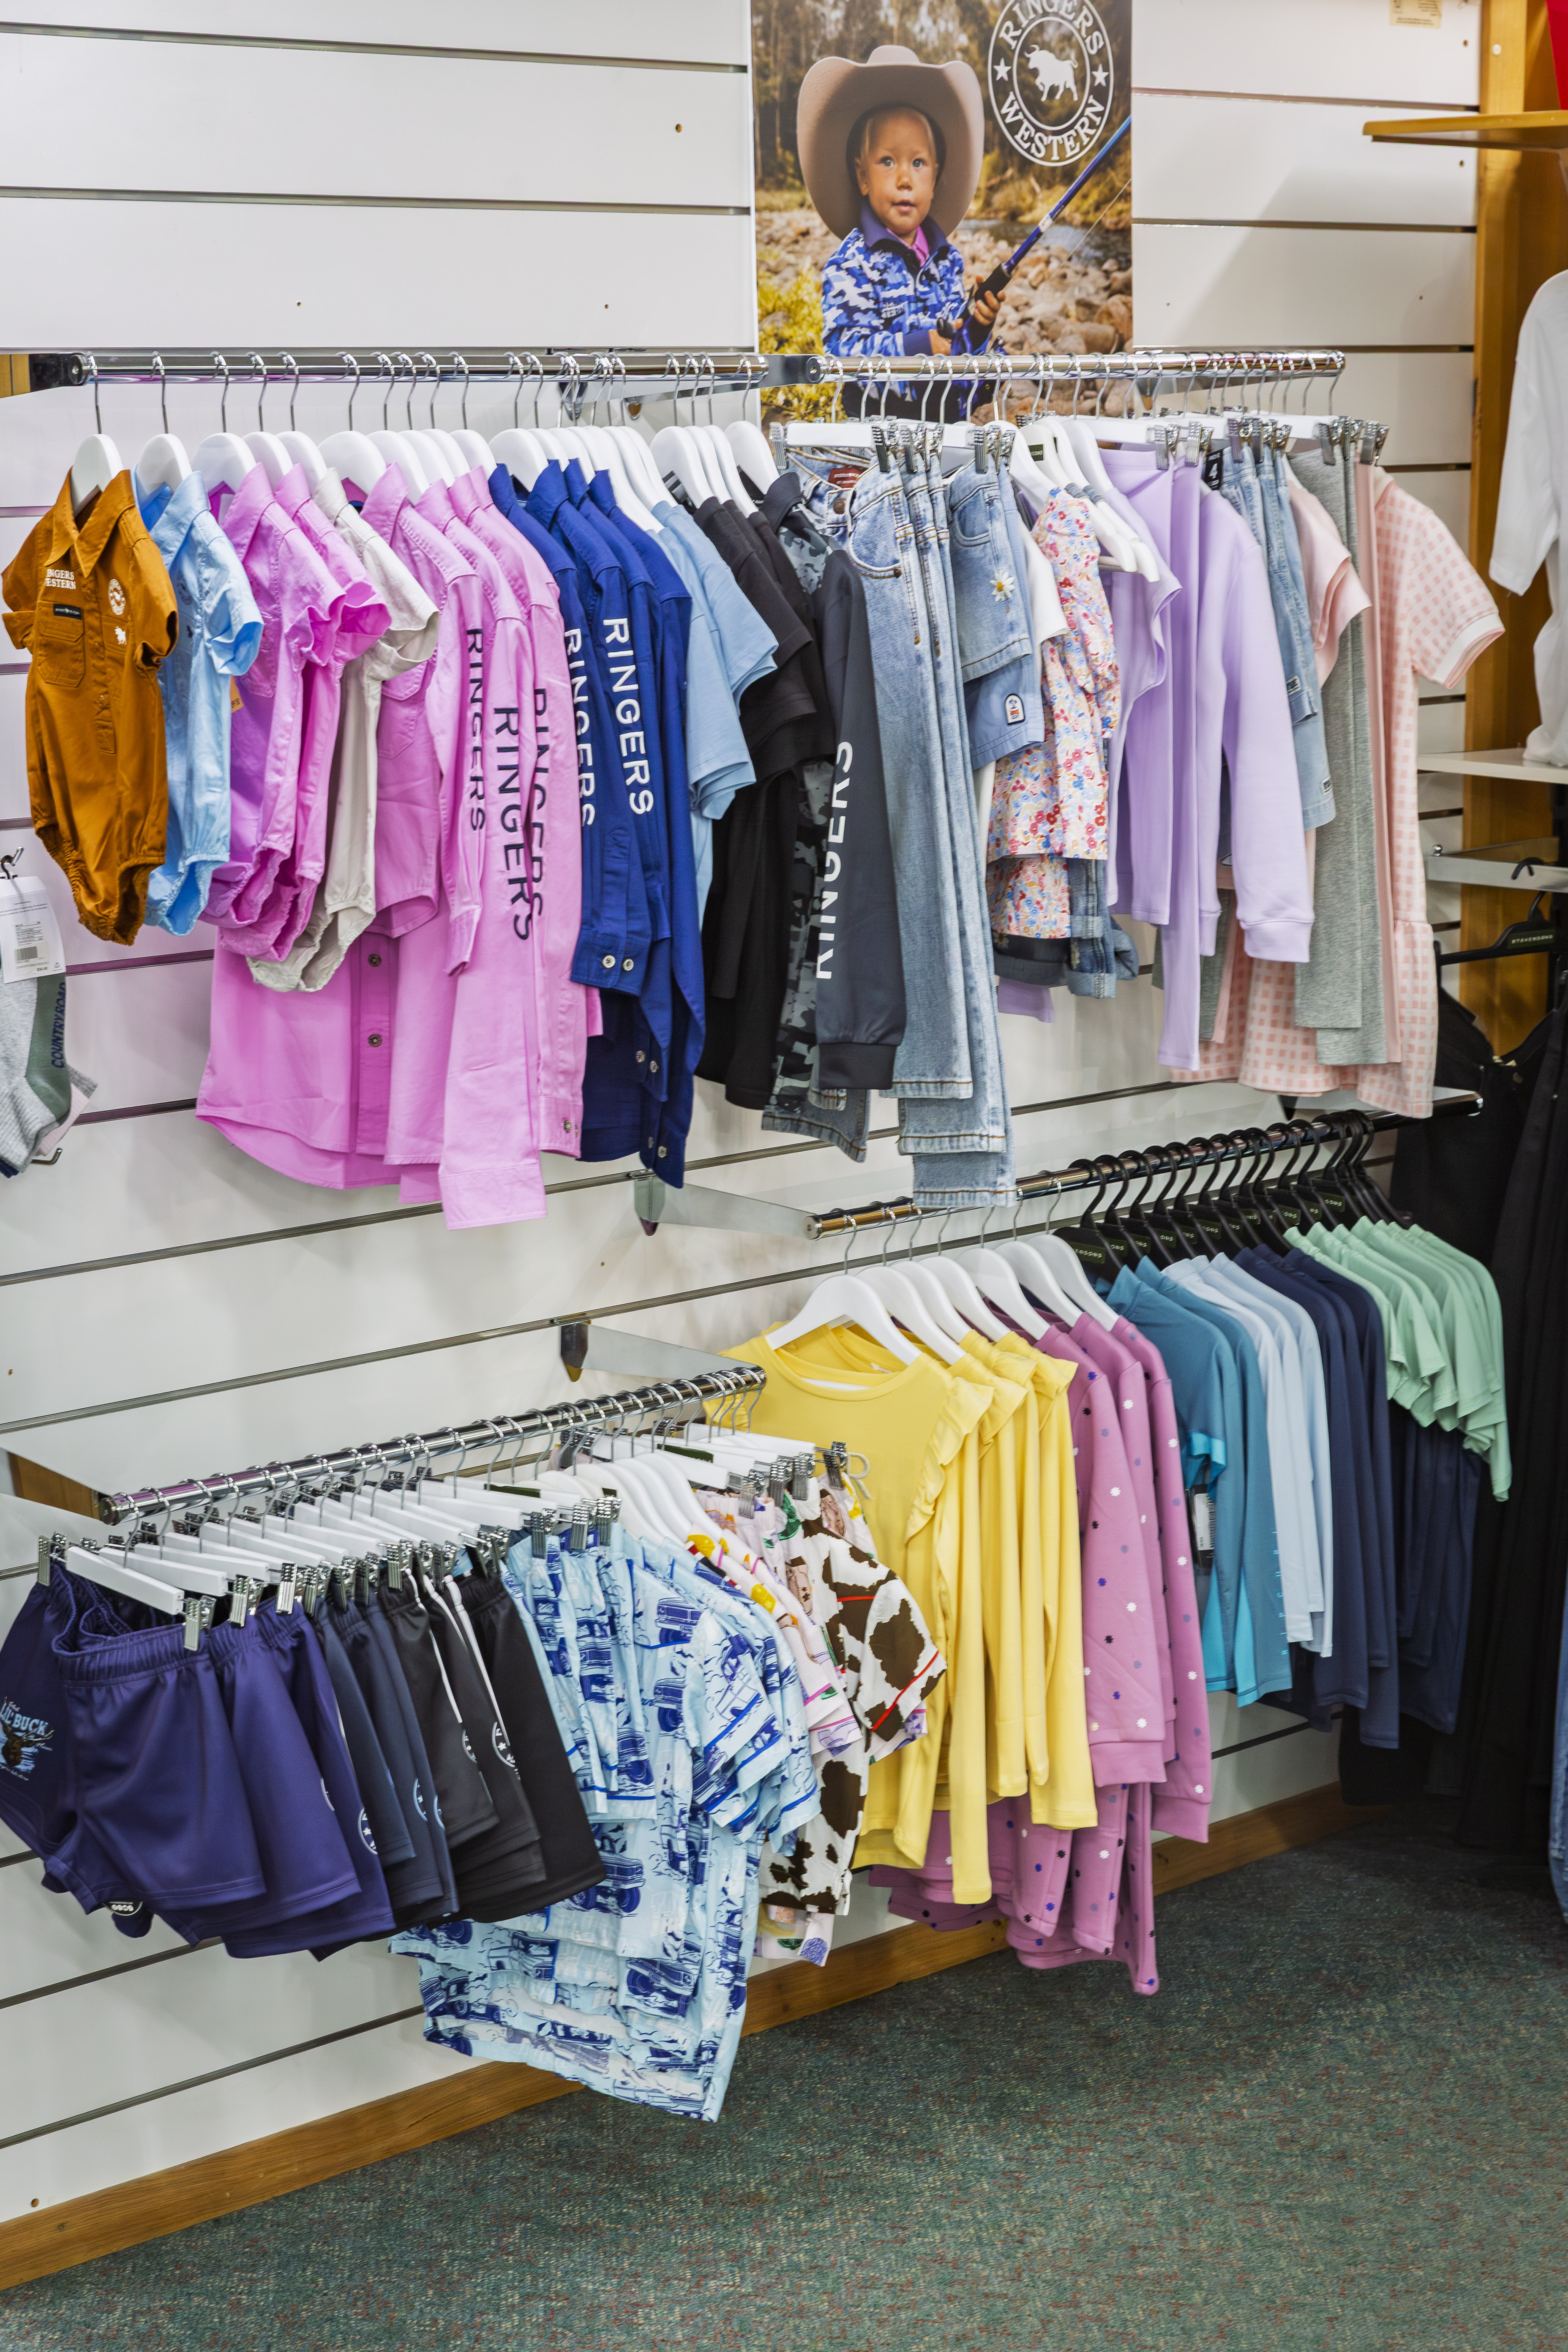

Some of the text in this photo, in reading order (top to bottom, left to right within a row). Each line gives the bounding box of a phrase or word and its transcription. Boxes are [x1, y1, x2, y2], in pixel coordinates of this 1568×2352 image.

[999, 0, 1105, 55] RINGERS
[1001, 91, 1105, 161] WESTERN
[1208, 463, 1218, 479] 4
[44, 578, 76, 590] ESTERN
[46, 569, 75, 580] INGERS
[466, 628, 486, 831] RINGERS
[564, 628, 595, 827] RINGERS
[603, 617, 654, 815] RINGERS
[494, 707, 533, 940] RINGERS
[11, 1713, 49, 1736] BUCK
